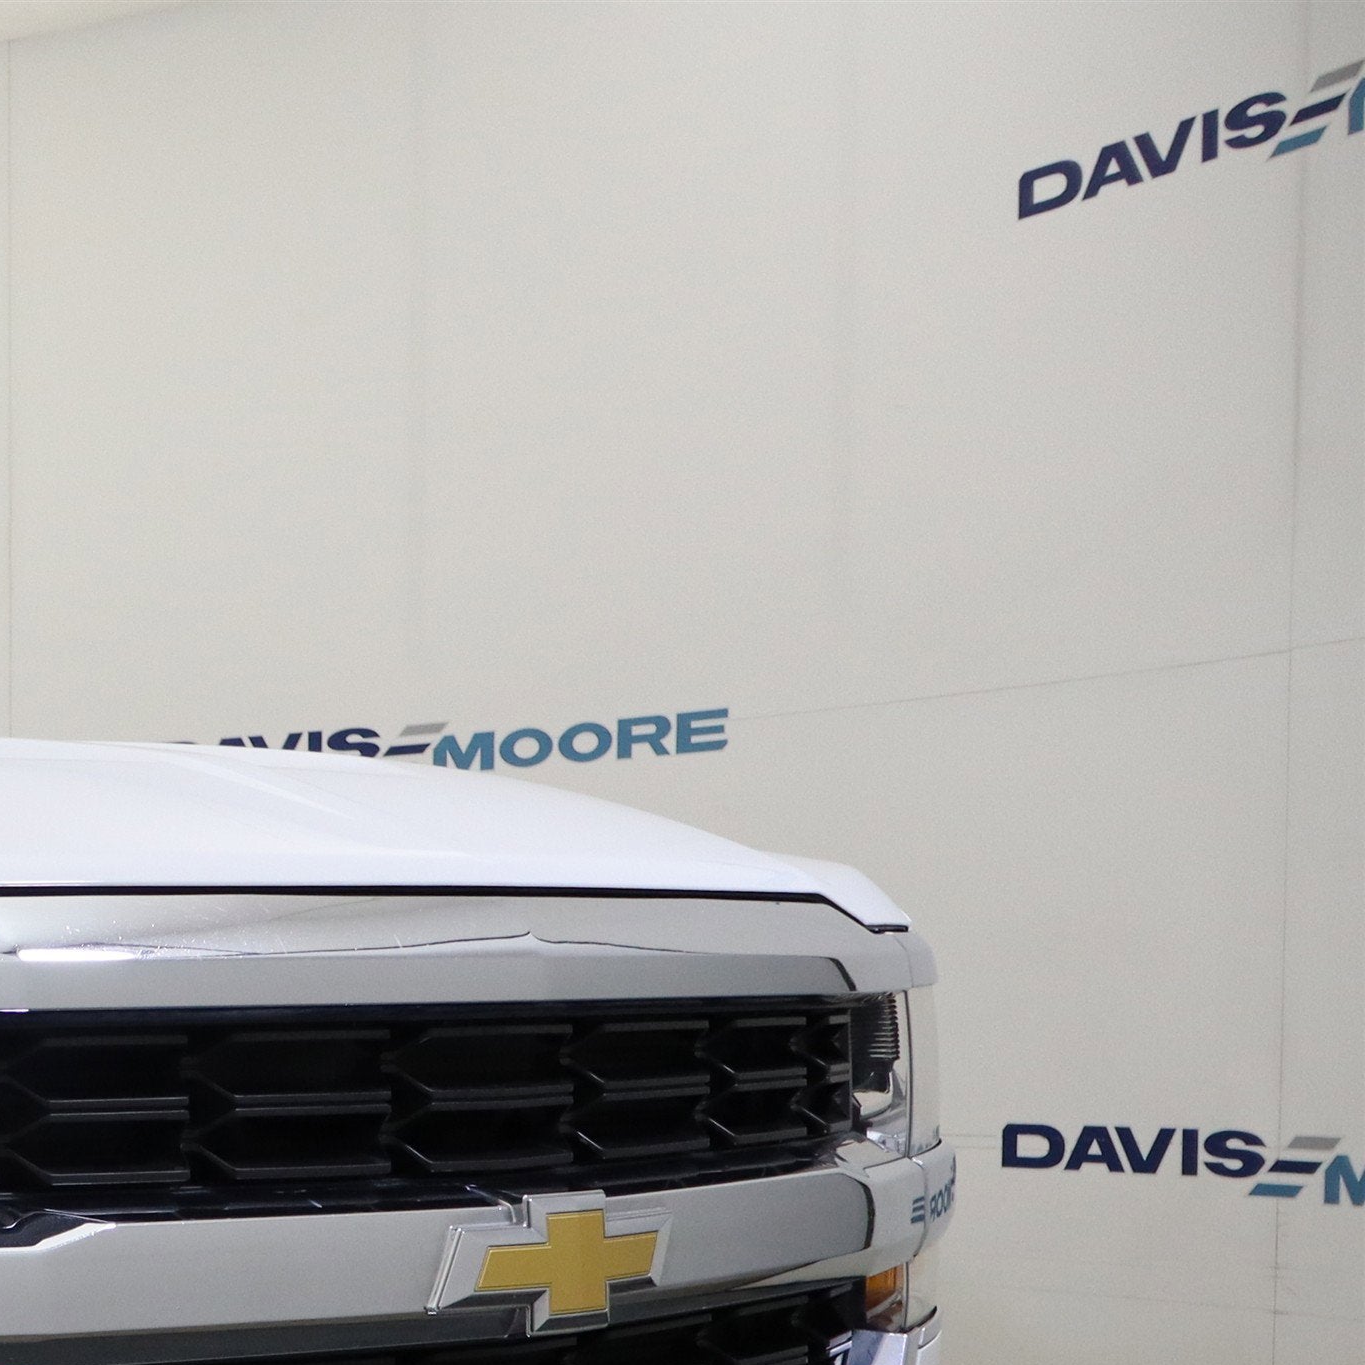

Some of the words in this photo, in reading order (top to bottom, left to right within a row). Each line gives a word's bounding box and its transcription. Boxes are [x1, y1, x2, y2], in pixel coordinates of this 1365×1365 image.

[1018, 91, 1288, 220] DAVIS
[432, 707, 729, 771] MOORE
[1001, 1122, 1267, 1179] DAVIS
